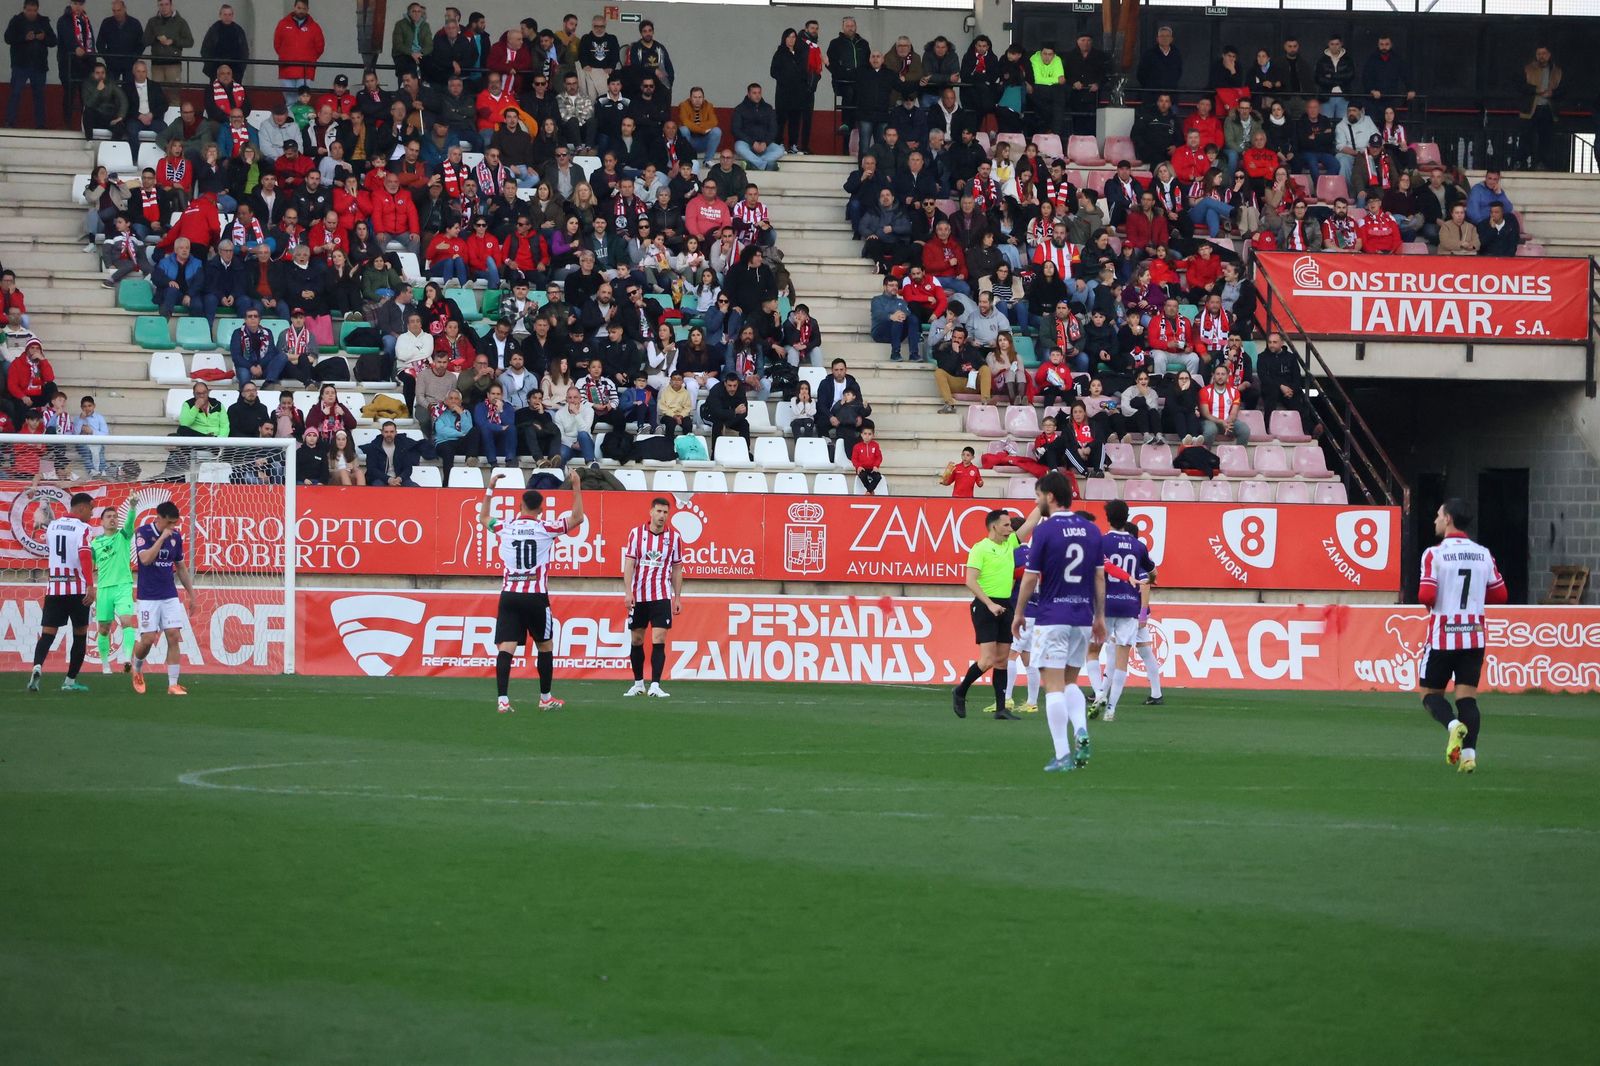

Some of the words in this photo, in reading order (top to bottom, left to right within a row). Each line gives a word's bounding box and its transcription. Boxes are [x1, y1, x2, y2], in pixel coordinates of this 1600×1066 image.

[1515, 319, 1551, 336] S.A.
[34, 489, 64, 499] ONDO
[294, 508, 423, 545] ÓPTICO
[849, 504, 1025, 554] ZAMO
[1062, 527, 1087, 538] LUCAS
[1240, 515, 1265, 557] 8
[1353, 517, 1378, 559] 8
[55, 534, 67, 564] 4
[202, 542, 361, 569] ROBERTO
[511, 538, 537, 570] 10
[1063, 542, 1085, 584] 2
[1208, 535, 1248, 584] ZAMORA
[1322, 536, 1361, 586] ZAMORA
[696, 565, 754, 575] BIOMECÁNICA
[846, 560, 968, 578] AYUNTAMIENT
[1458, 568, 1472, 610] 7
[422, 616, 633, 657] FRAY
[728, 603, 932, 639] PERSIANAS
[670, 641, 936, 682] ZAMORANAS
[1247, 619, 1328, 680] CF
